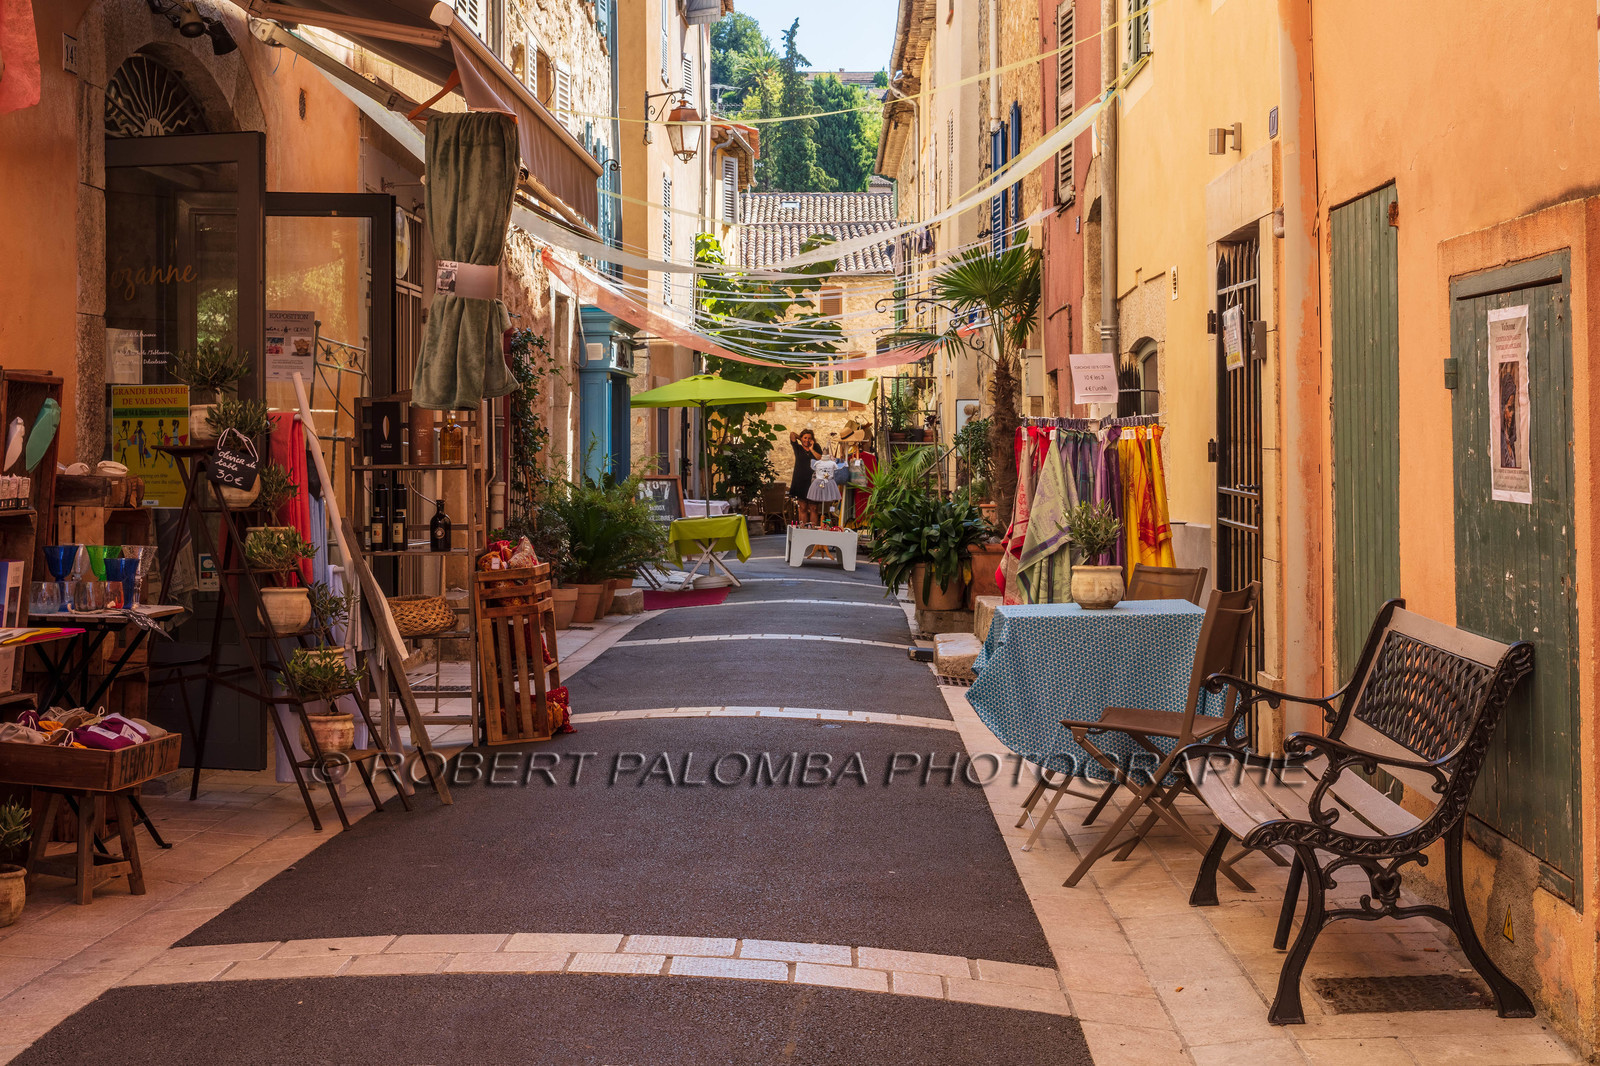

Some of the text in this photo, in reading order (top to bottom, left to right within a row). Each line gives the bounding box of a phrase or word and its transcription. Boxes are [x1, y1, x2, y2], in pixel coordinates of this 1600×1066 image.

[269, 312, 309, 320] EXPOSITION
[113, 386, 188, 395] GRANDE BRADERIE
[135, 397, 178, 405] VALBONNE
[215, 458, 238, 471] table
[216, 468, 244, 486] 30€
